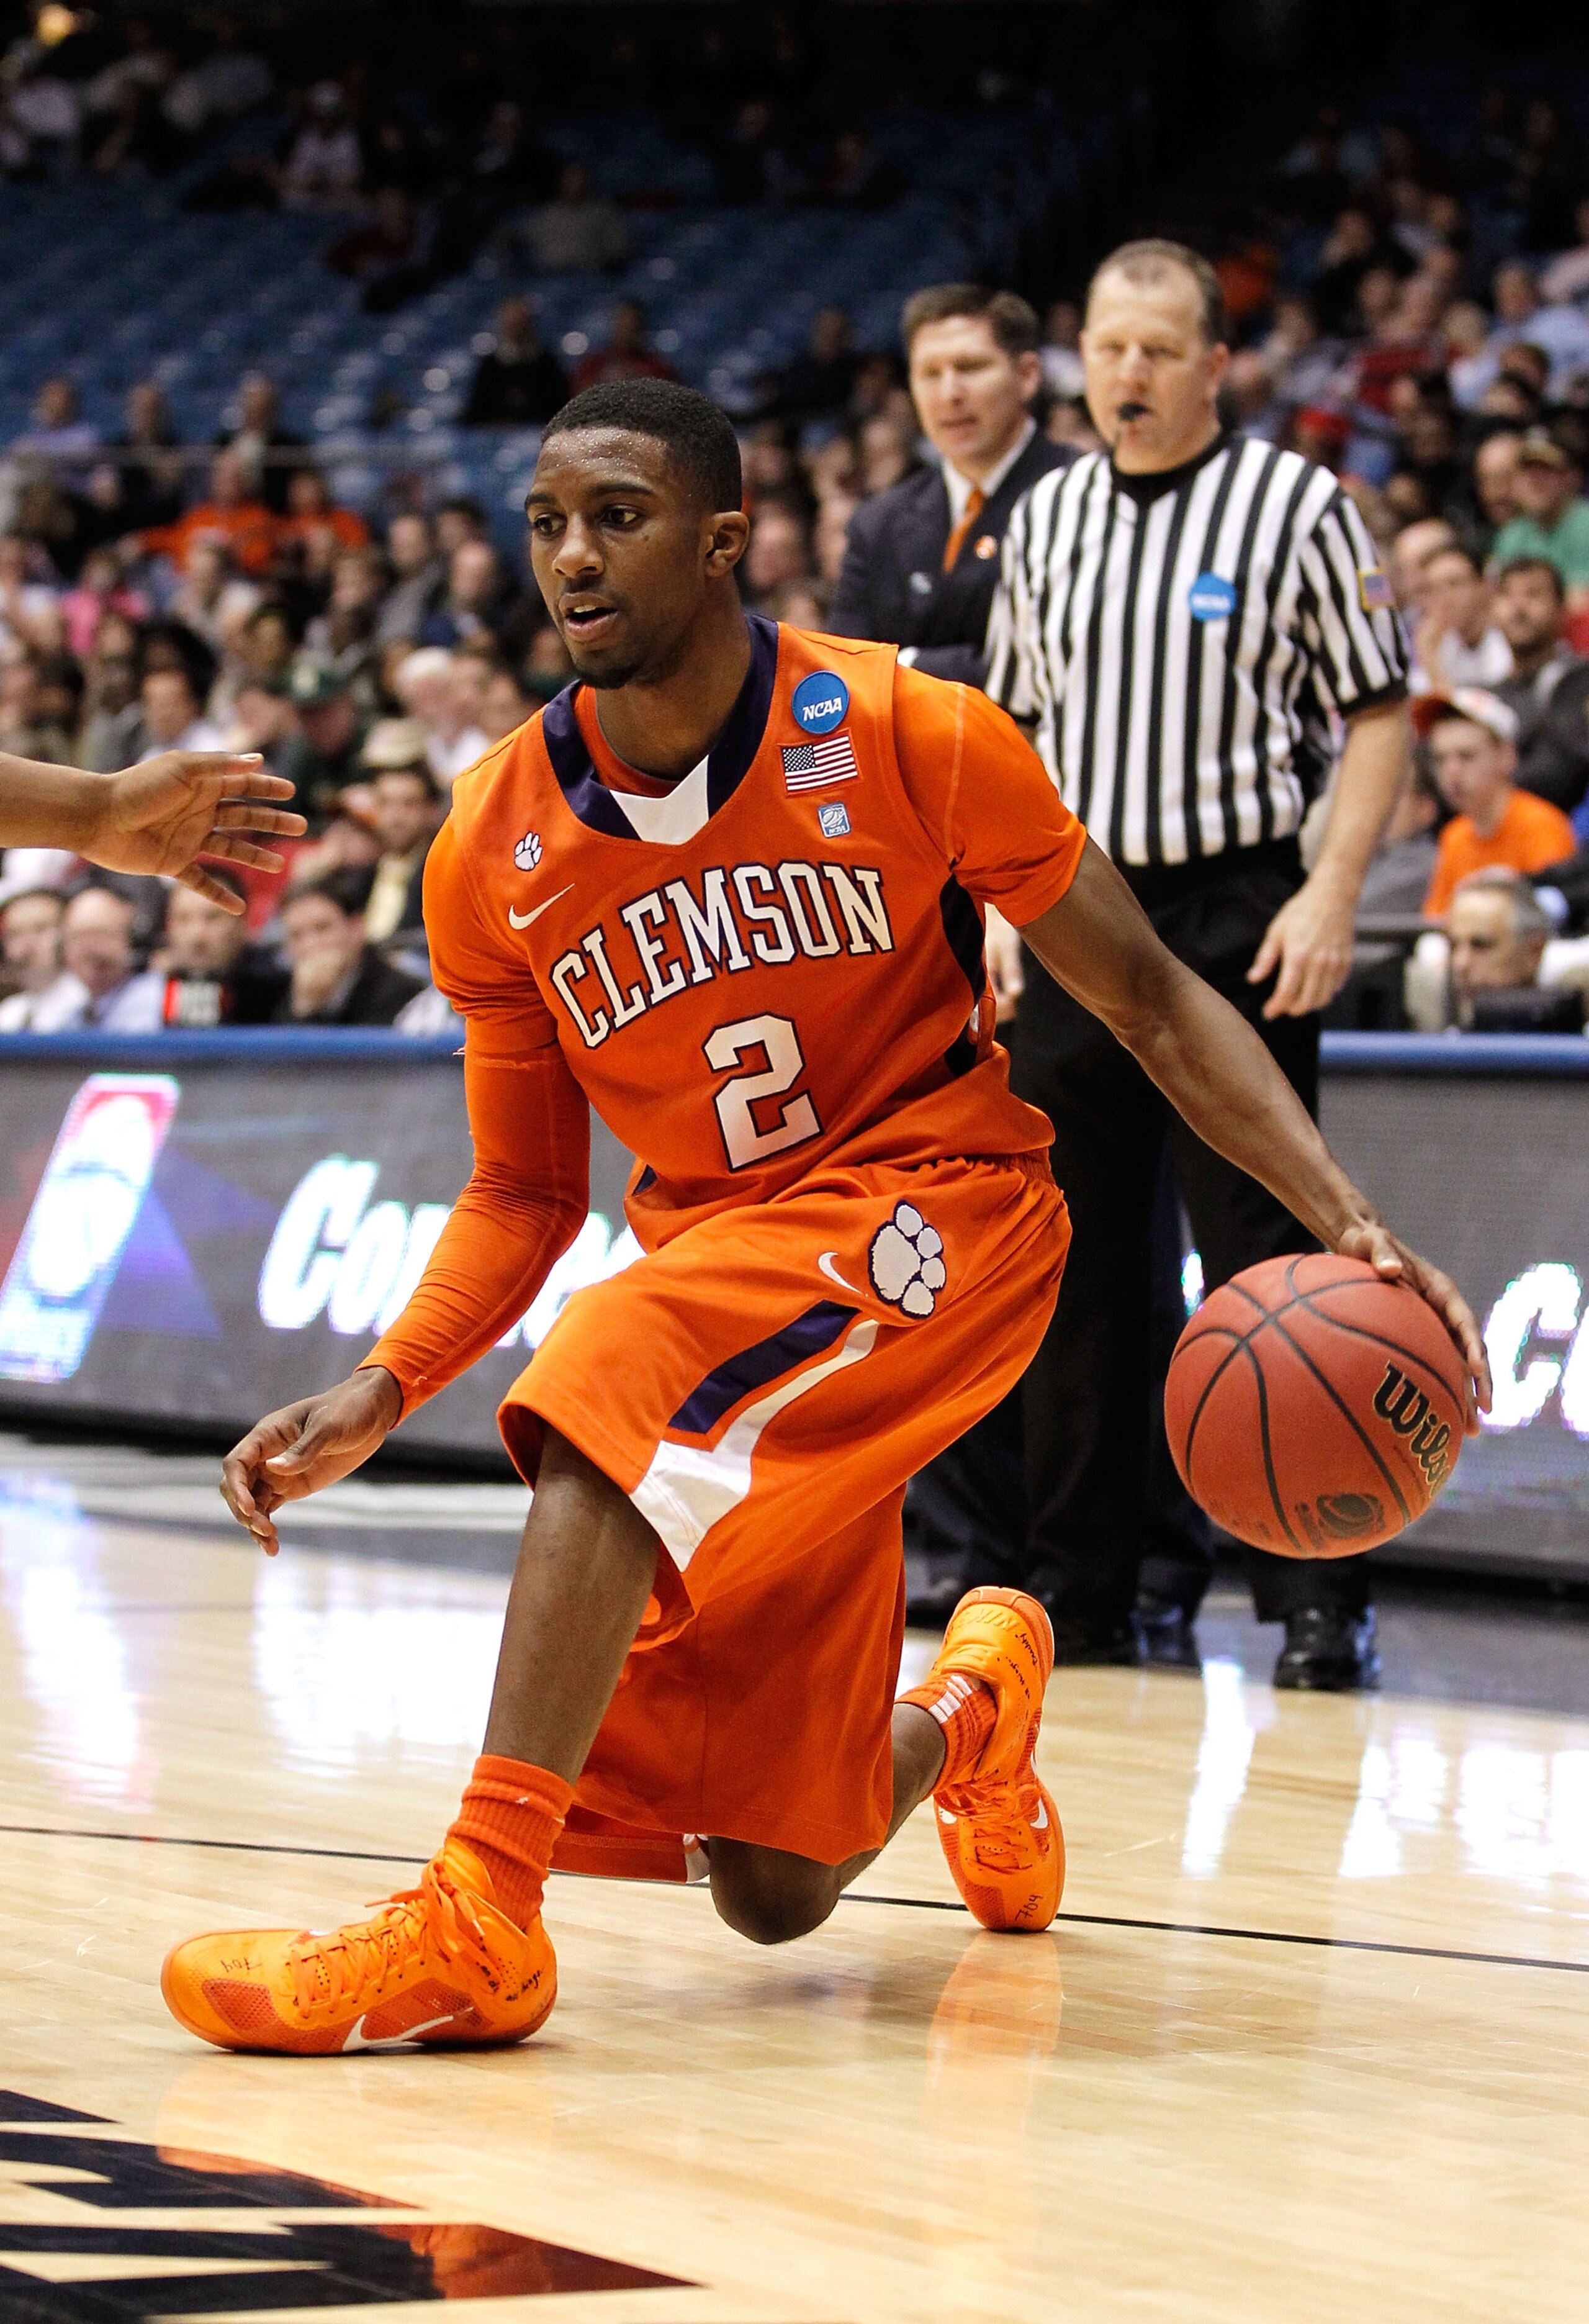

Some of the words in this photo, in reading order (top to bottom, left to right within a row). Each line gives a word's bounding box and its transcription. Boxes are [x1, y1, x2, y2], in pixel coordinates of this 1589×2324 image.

[802, 696, 842, 722] NCAA
[550, 860, 896, 1051] CLEMSON
[701, 1011, 825, 1170] 2
[1372, 1359, 1451, 1499] Wils
